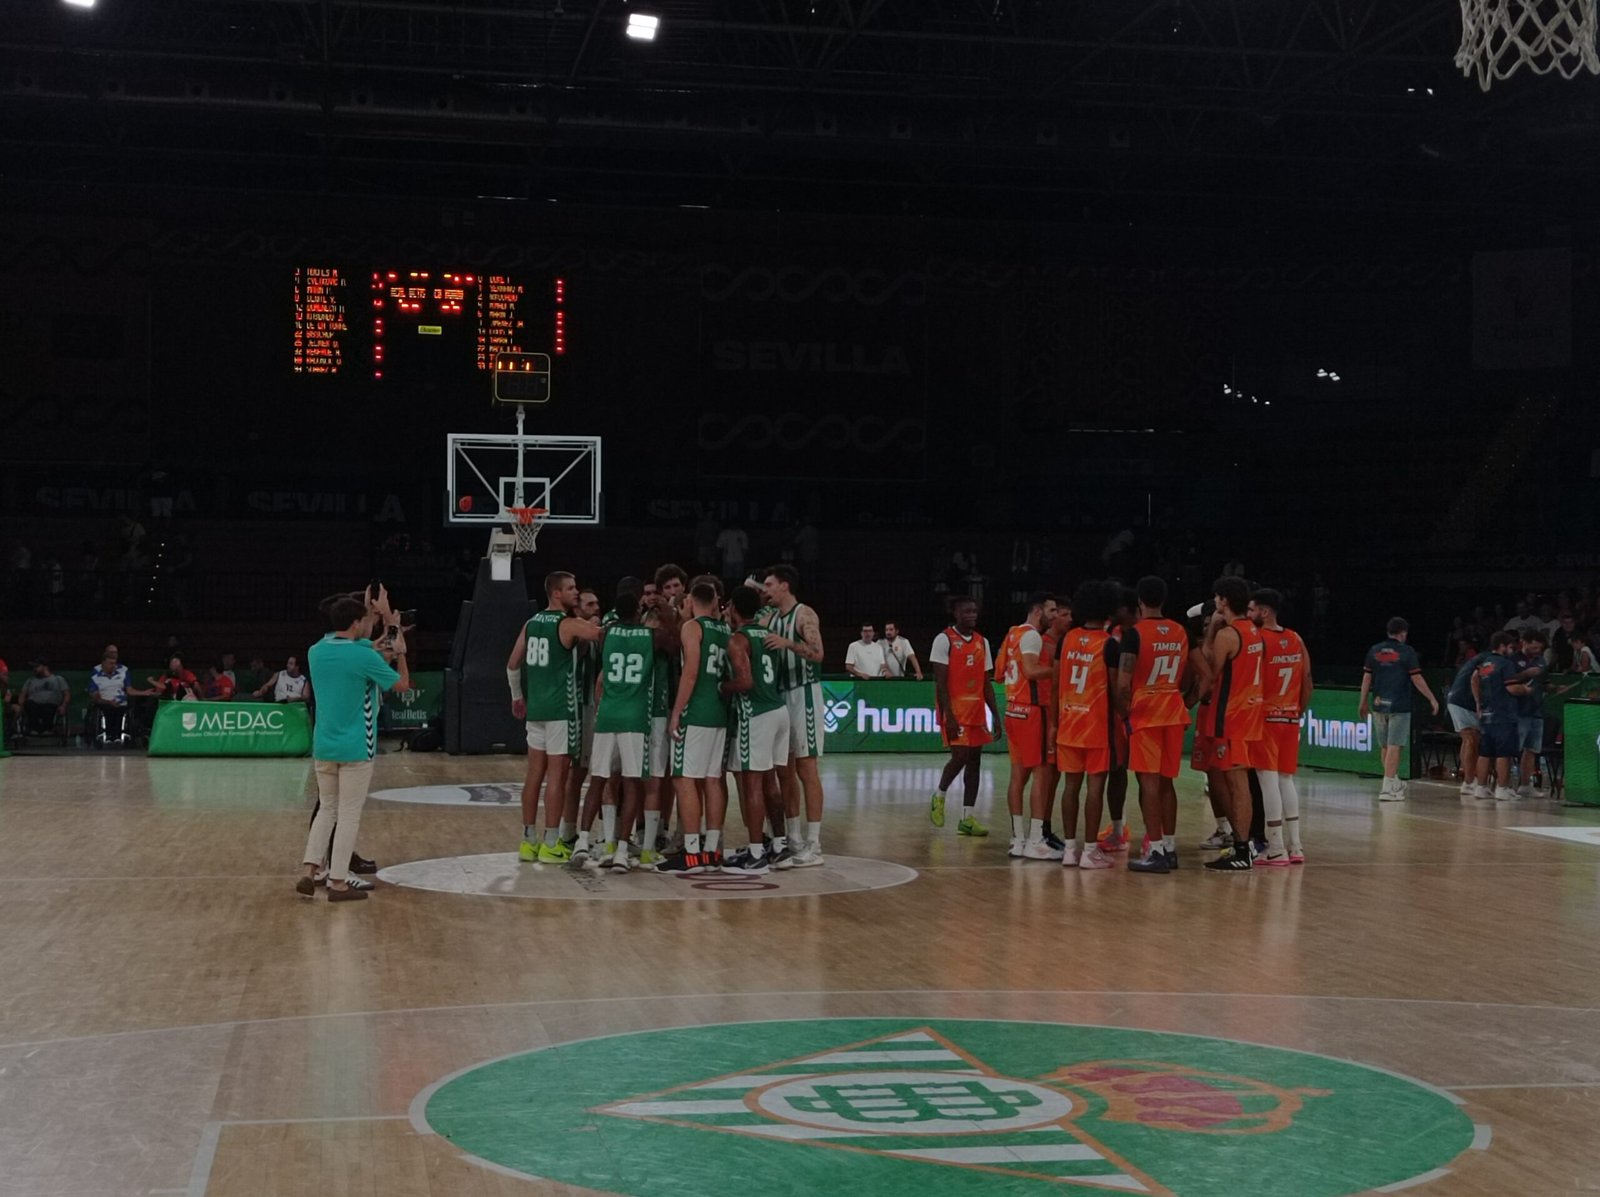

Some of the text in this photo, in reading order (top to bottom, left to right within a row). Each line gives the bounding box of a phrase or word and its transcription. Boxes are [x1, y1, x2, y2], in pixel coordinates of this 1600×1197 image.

[713, 340, 911, 375] SEVILLA
[36, 486, 197, 511] SEVILA
[526, 636, 549, 667] 88
[1152, 642, 1181, 652] TAMBA
[607, 652, 643, 684] 32
[762, 654, 774, 684] 3
[1070, 665, 1089, 694] 4
[1146, 655, 1181, 686] 14
[1278, 667, 1293, 696] 7
[199, 710, 284, 730] MEDAC
[1308, 709, 1372, 752] hummel
